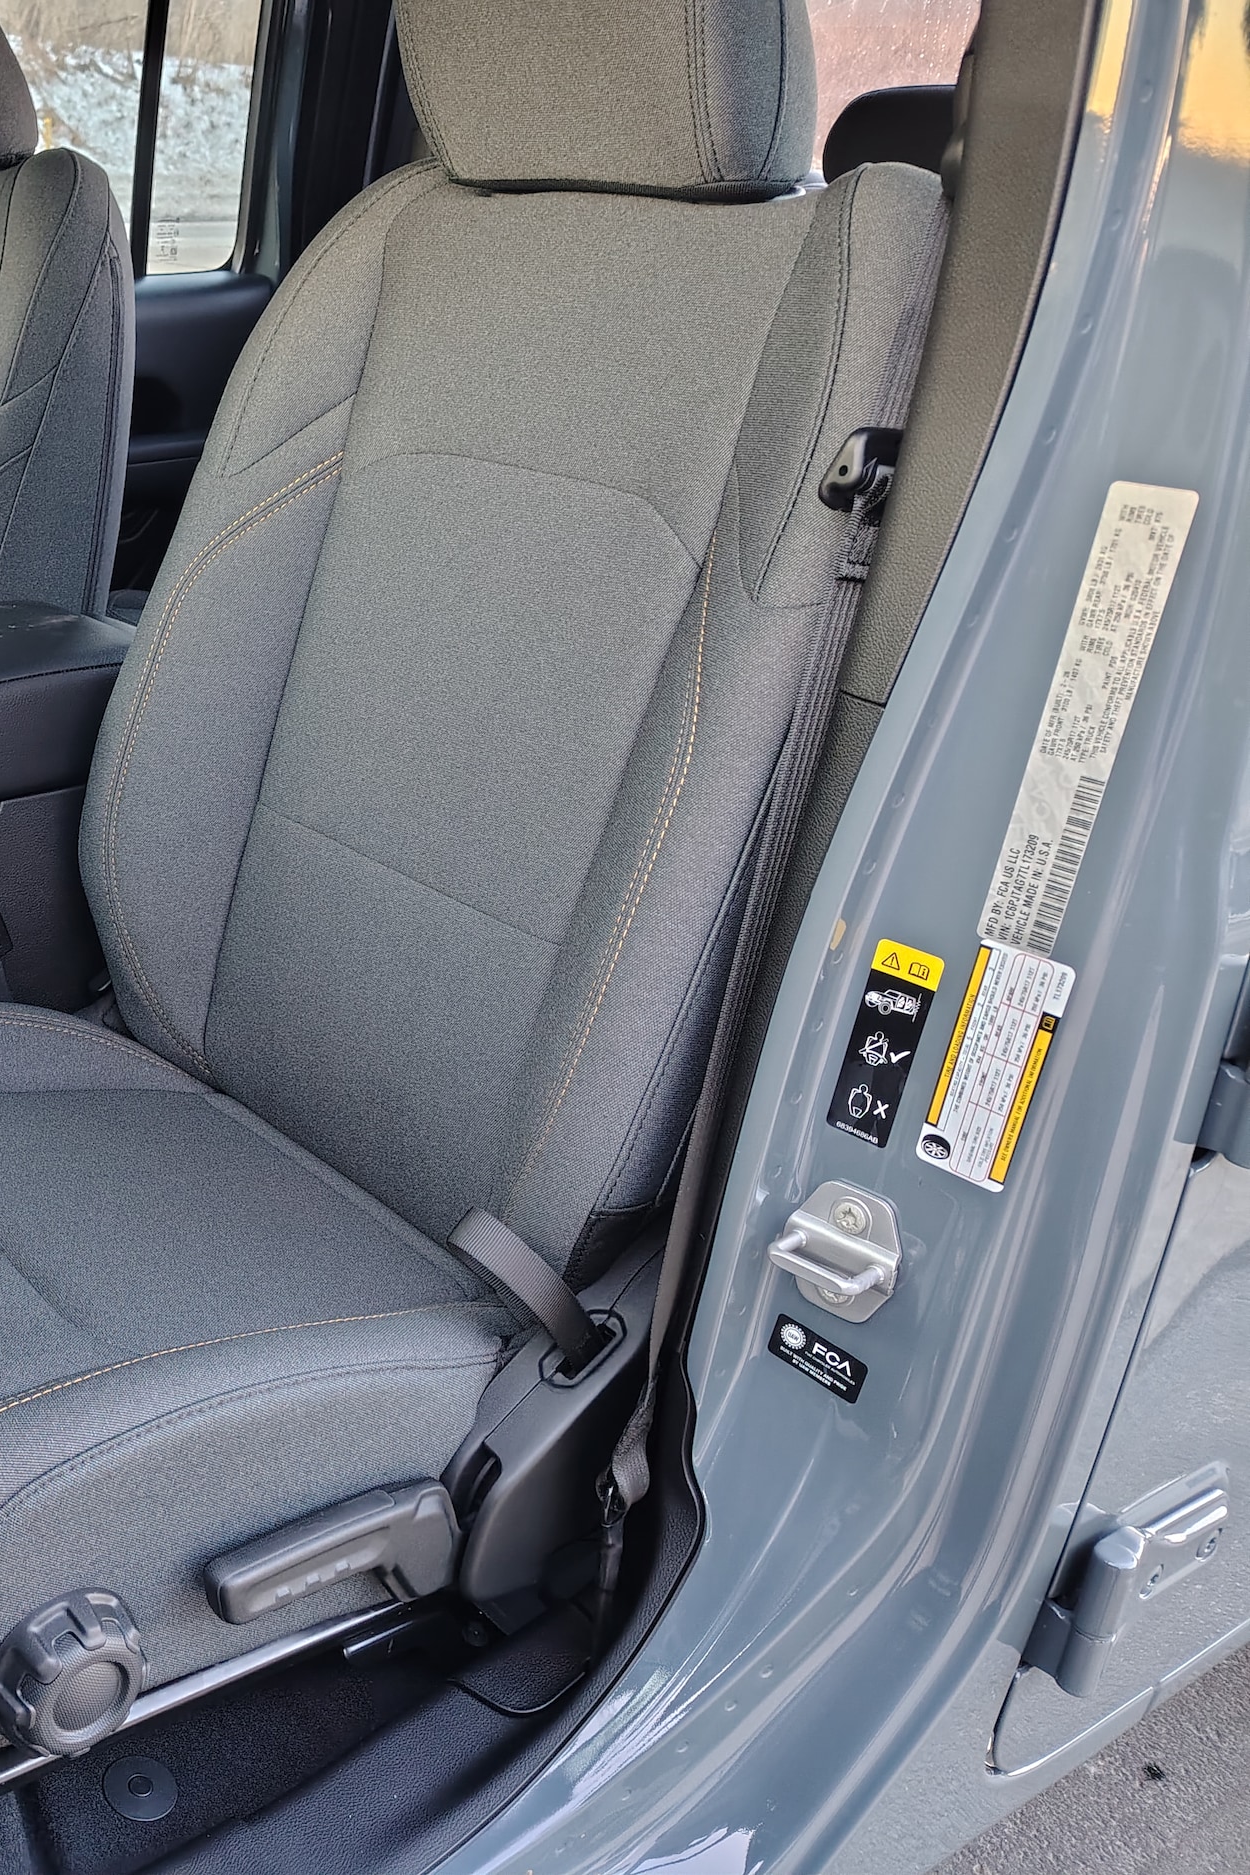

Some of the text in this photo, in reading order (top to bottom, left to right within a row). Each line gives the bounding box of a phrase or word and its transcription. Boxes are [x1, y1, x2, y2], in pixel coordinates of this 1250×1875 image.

[1086, 638, 1097, 653] RIMS
[1093, 637, 1105, 654] TIRES
[1130, 620, 1148, 657] STANDARDS
[1117, 658, 1136, 696] PREVENTION
[1124, 656, 1145, 701] MANUFACTURE
[1139, 632, 1153, 655] SHOWN
[1047, 737, 1058, 756] GAWR
[1079, 634, 1089, 651] WITH
[1111, 696, 1123, 716] THEFT
[1047, 715, 1057, 728] MFR
[1088, 745, 1100, 759] THIS
[1094, 720, 1108, 744] VEHICLE
[1101, 686, 1118, 719] CONFORMS
[1112, 677, 1121, 685] TO
[1107, 717, 1117, 730] AND
[1044, 729, 1052, 737] OF
[1083, 726, 1096, 745] TRUCK
[1099, 731, 1112, 754] SAFETY
[1039, 738, 1050, 754] DATE
[984, 847, 1021, 937] MFD BY: FCA US LLC
[997, 834, 1040, 941] VIN: 1C6PJTAG7TL173209
[1009, 840, 1054, 945] VEHICLE MADE IN: U.S.A.
[960, 993, 976, 1030] INFORMATION
[952, 1030, 964, 1054] LOADING
[948, 1054, 957, 1065] AND
[944, 1066, 953, 1078] TIRE
[787, 1330, 800, 1342] UAW
[793, 1353, 805, 1363] WITH
[804, 1361, 823, 1376] QUALITY
[823, 1373, 834, 1382] AND
[812, 1342, 851, 1377] FCA
